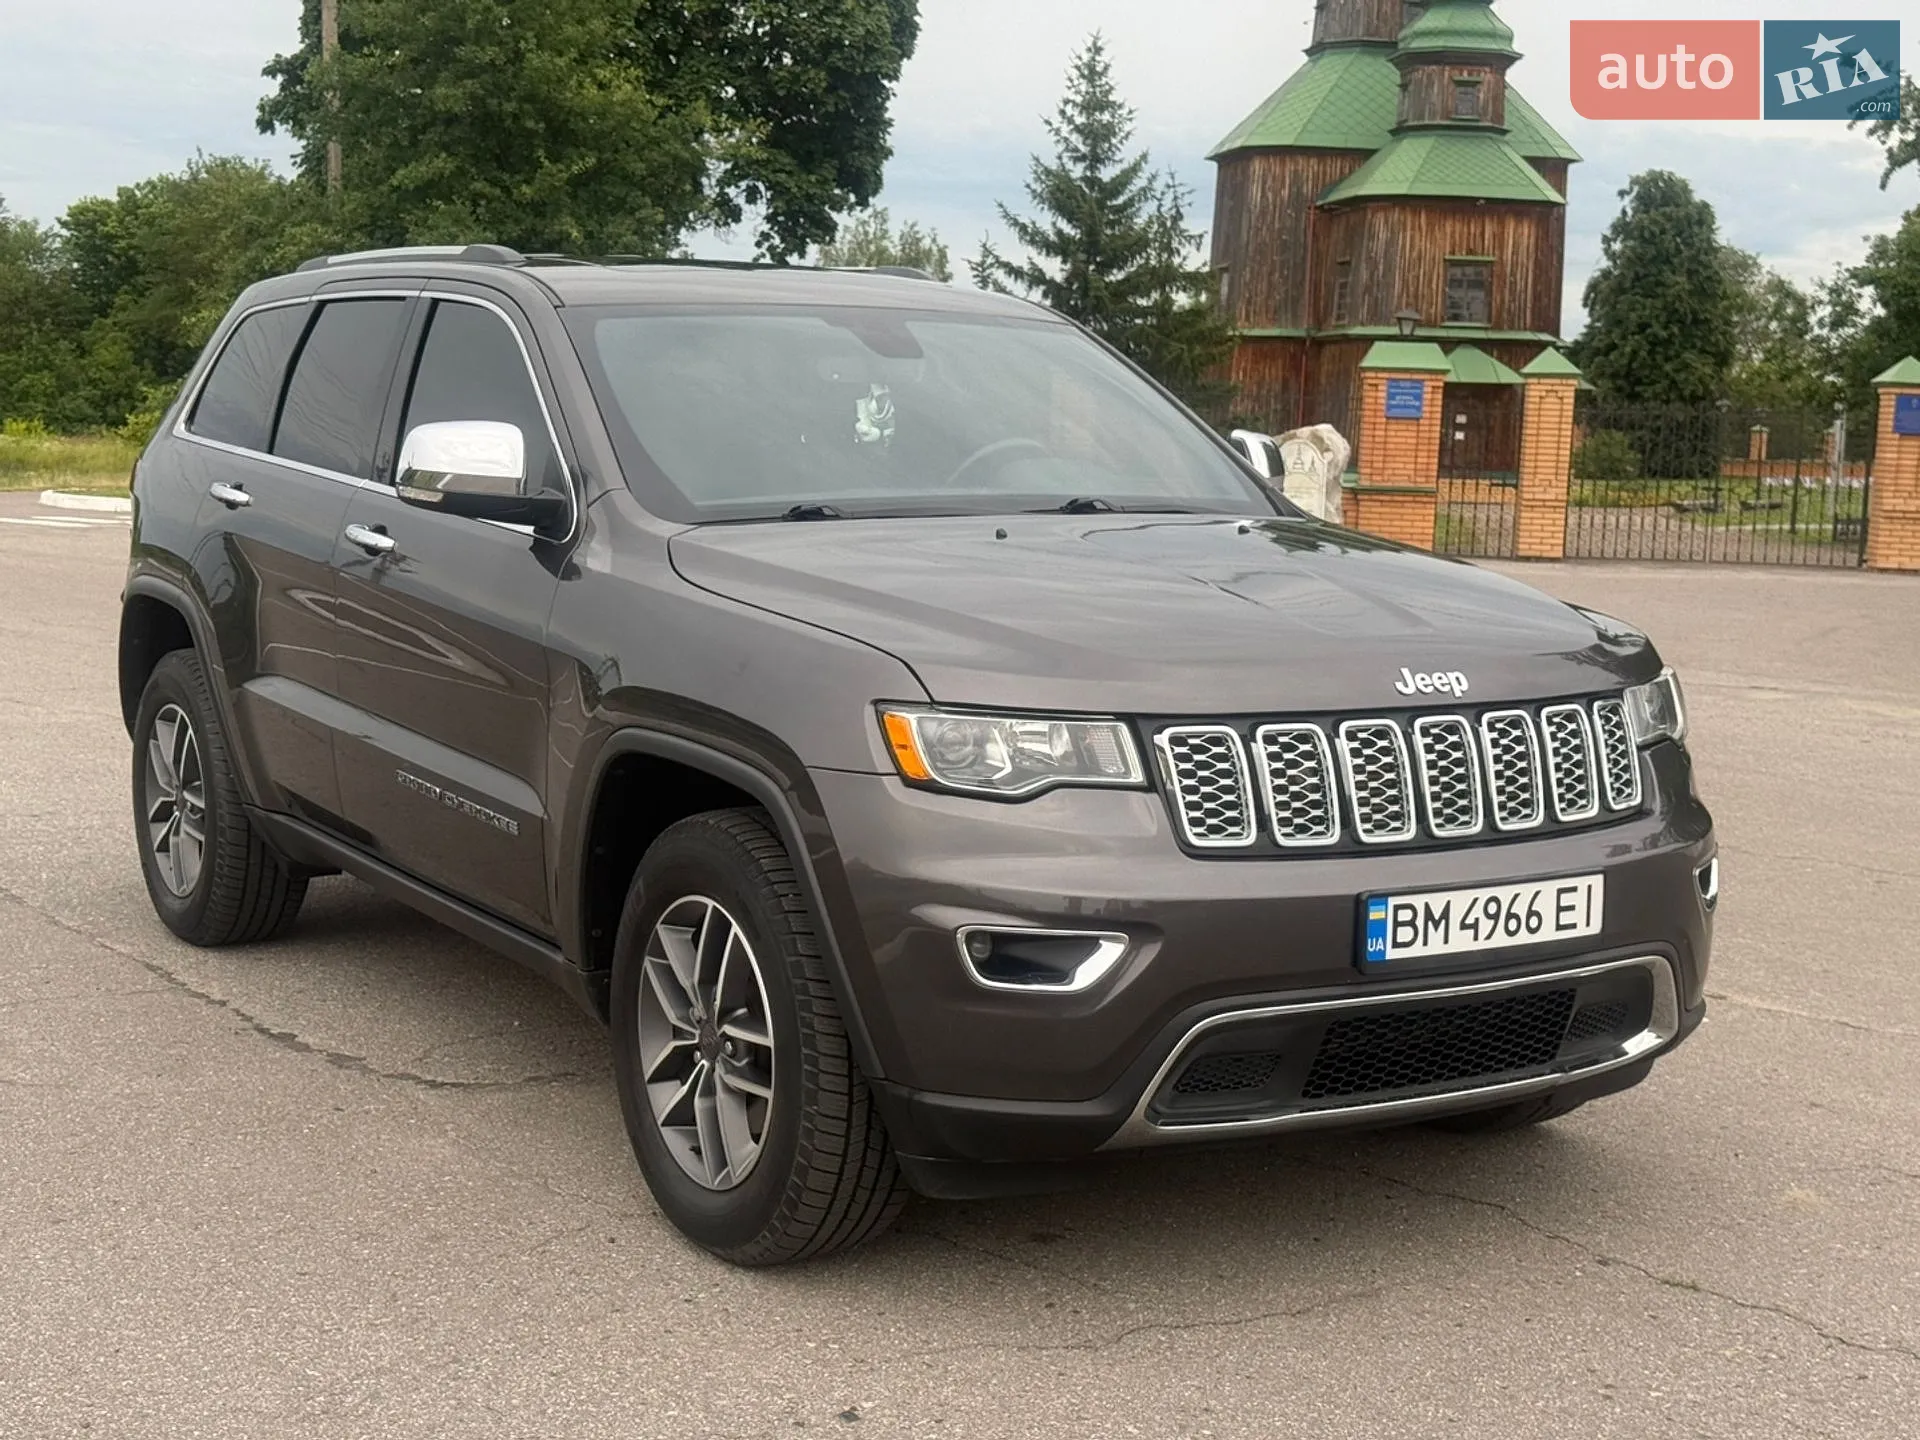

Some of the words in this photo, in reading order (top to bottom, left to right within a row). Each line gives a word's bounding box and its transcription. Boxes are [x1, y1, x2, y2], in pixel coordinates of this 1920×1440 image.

[1394, 667, 1469, 698] Jeep
[1391, 899, 1451, 949] BM
[1459, 889, 1542, 942] 4966
[1555, 884, 1593, 931] EI
[1367, 938, 1385, 952] UA
